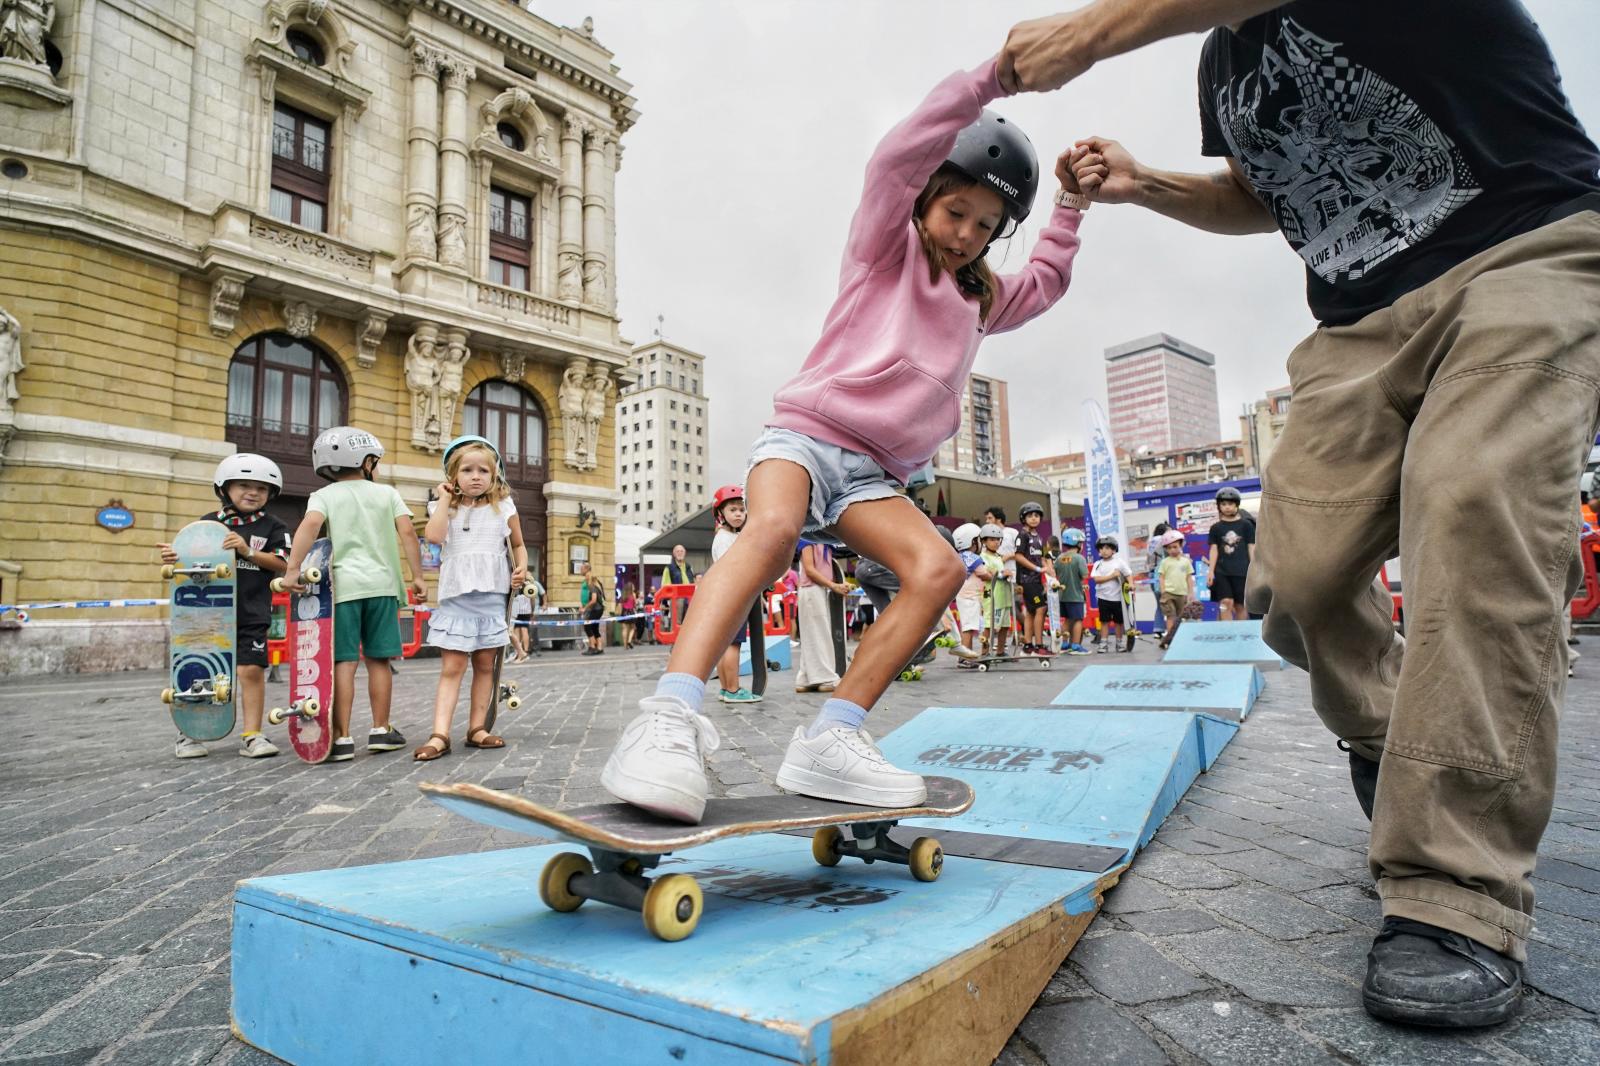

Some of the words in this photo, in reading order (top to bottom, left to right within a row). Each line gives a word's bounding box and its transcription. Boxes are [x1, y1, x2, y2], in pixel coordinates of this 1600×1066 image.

[987, 171, 1020, 198] WAYOUT
[1310, 247, 1330, 269] LIVE
[1334, 238, 1344, 257] AT
[349, 436, 373, 448] GURE
[917, 747, 1045, 767] GURE
